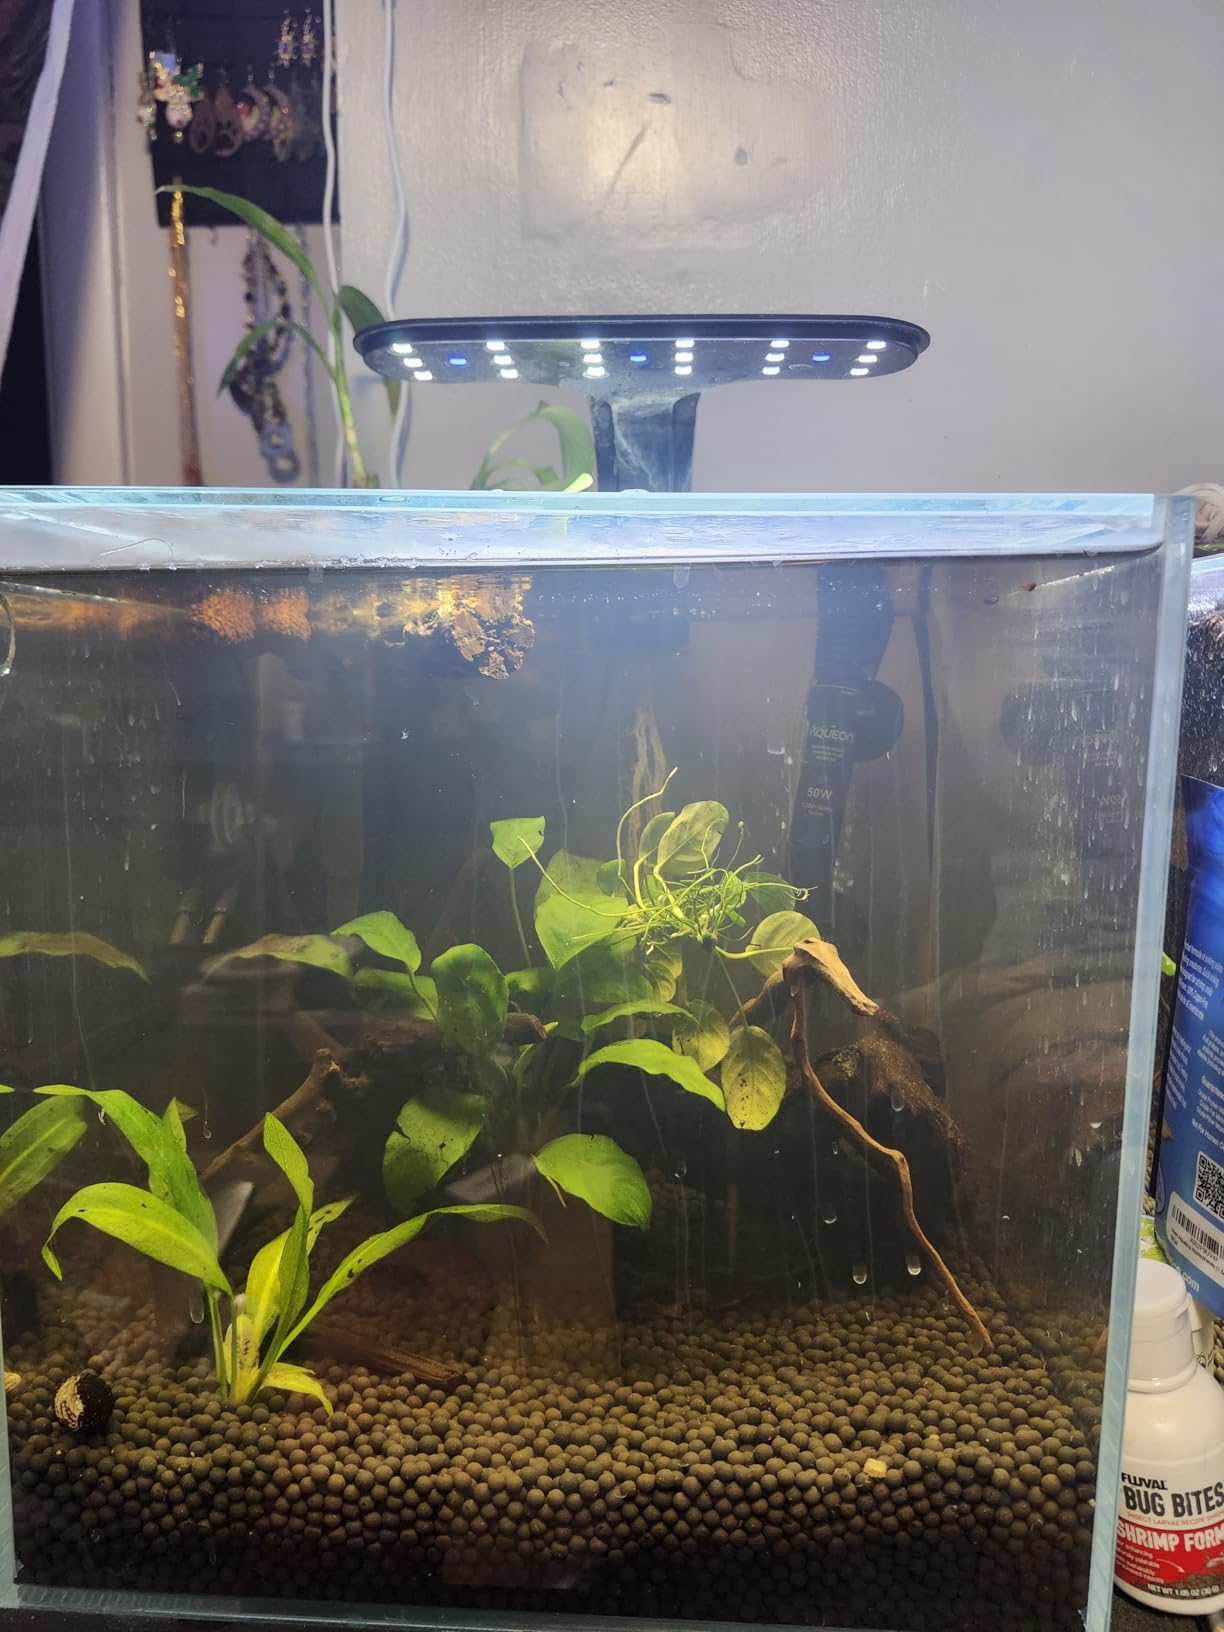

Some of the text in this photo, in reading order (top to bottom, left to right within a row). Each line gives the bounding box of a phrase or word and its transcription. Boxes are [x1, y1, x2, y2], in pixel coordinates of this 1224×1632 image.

[807, 787, 832, 801] 50W
[1121, 1472, 1168, 1490] FLUVAL
[1123, 1482, 1224, 1518] BUG BITES
[1117, 1520, 1180, 1552] SHRIMP
[1147, 1583, 1161, 1593] NET
[1162, 1587, 1173, 1595] WT
